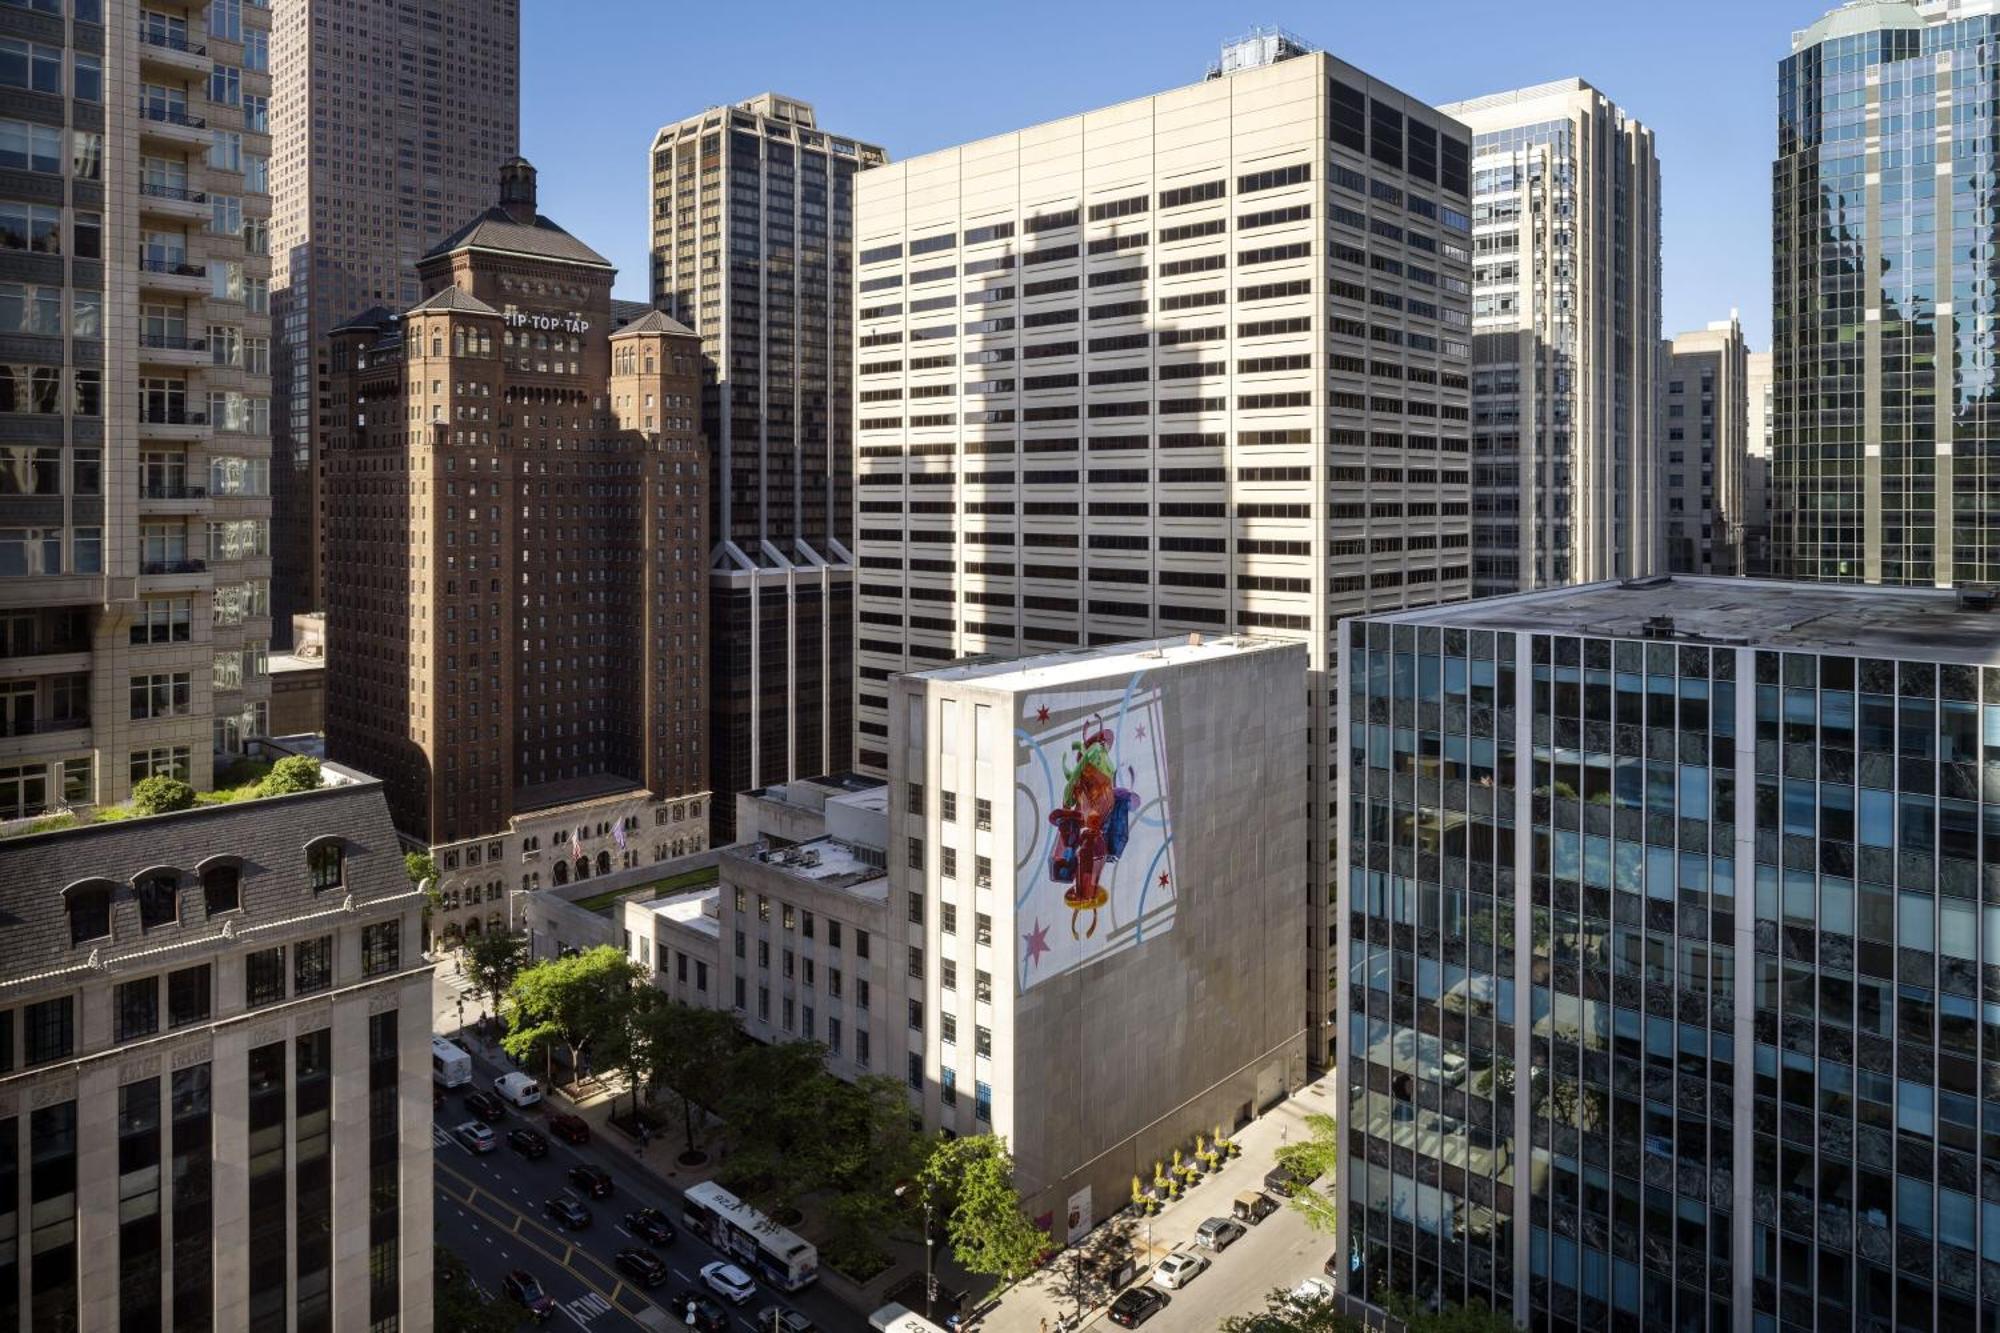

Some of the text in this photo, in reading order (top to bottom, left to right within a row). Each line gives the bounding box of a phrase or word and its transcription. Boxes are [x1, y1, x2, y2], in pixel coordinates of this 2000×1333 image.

[504, 313, 589, 334] TIP TOP TAP
[565, 1292, 613, 1325] ONLY
